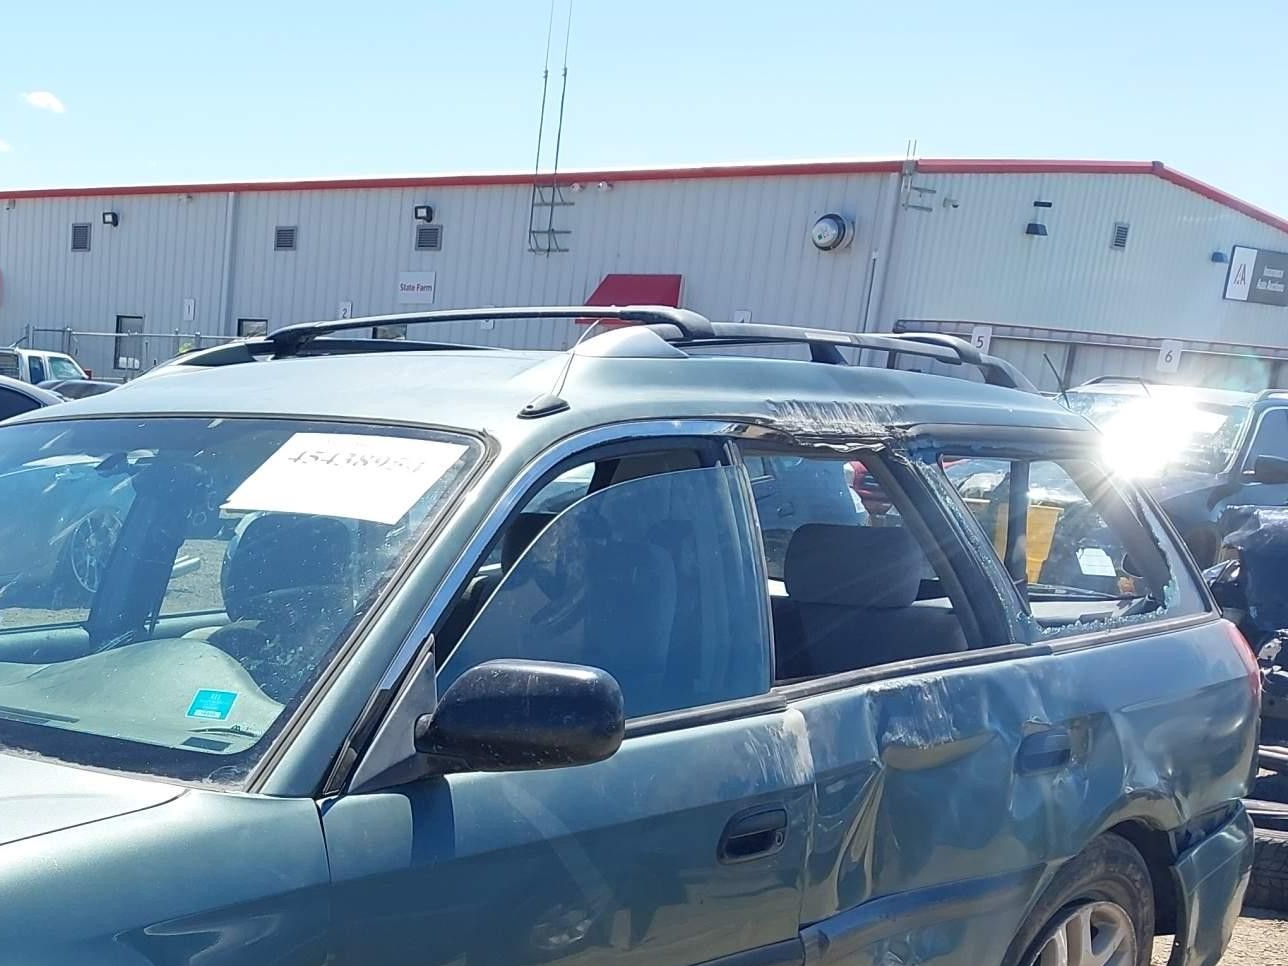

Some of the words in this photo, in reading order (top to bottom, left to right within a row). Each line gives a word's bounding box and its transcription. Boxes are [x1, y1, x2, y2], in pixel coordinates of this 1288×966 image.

[400, 282, 415, 291] State
[416, 283, 432, 292] Farm
[342, 308, 347, 318] 2
[975, 336, 984, 349] 5
[1165, 350, 1173, 363] 6
